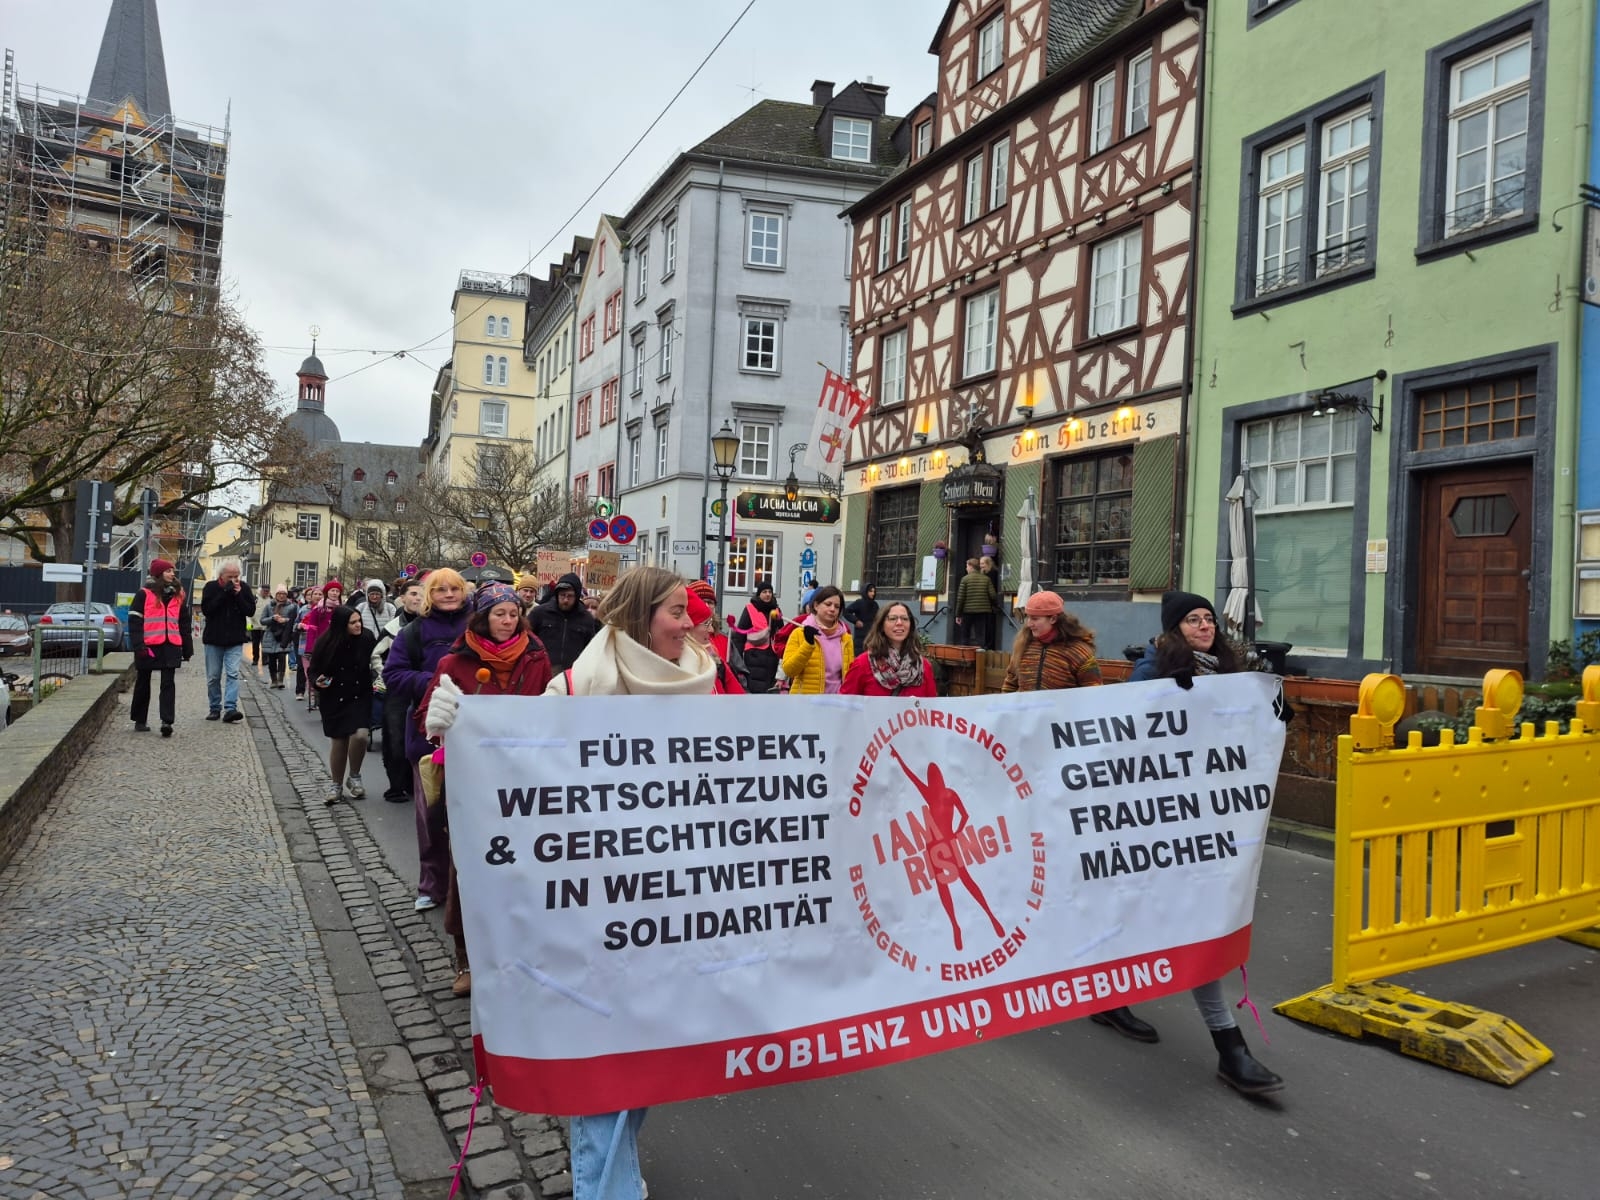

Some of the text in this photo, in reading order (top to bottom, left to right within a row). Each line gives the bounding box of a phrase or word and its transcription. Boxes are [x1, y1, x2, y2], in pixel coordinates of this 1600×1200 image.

[1011, 412, 1156, 457] Zum Hubertus
[759, 498, 769, 509] LA
[770, 499, 785, 510] CHA
[802, 500, 818, 512] CHA
[580, 733, 826, 768] FÜR RESPEKT,
[1050, 709, 1188, 750] NEIN ZU
[849, 709, 1033, 817] ONEBILLIONRISING.DE
[1061, 744, 1247, 791] GEWALT AN
[497, 772, 828, 818] WERTSCHÄTZUNG
[1070, 783, 1271, 836] FRAUEN UND
[485, 813, 830, 866] & GERECHTIGKEIT
[872, 804, 944, 865] I AM
[902, 815, 1013, 896] RISING!
[1080, 830, 1238, 881] MÄDCHEN
[545, 855, 832, 910] IN WELTWEITER
[849, 832, 1046, 982] BEWEGEN ERHEBEN LEBEN
[603, 892, 833, 951] SOLIDARITÄT
[725, 957, 1174, 1079] KOBLENZ UND UMGEBUNG
